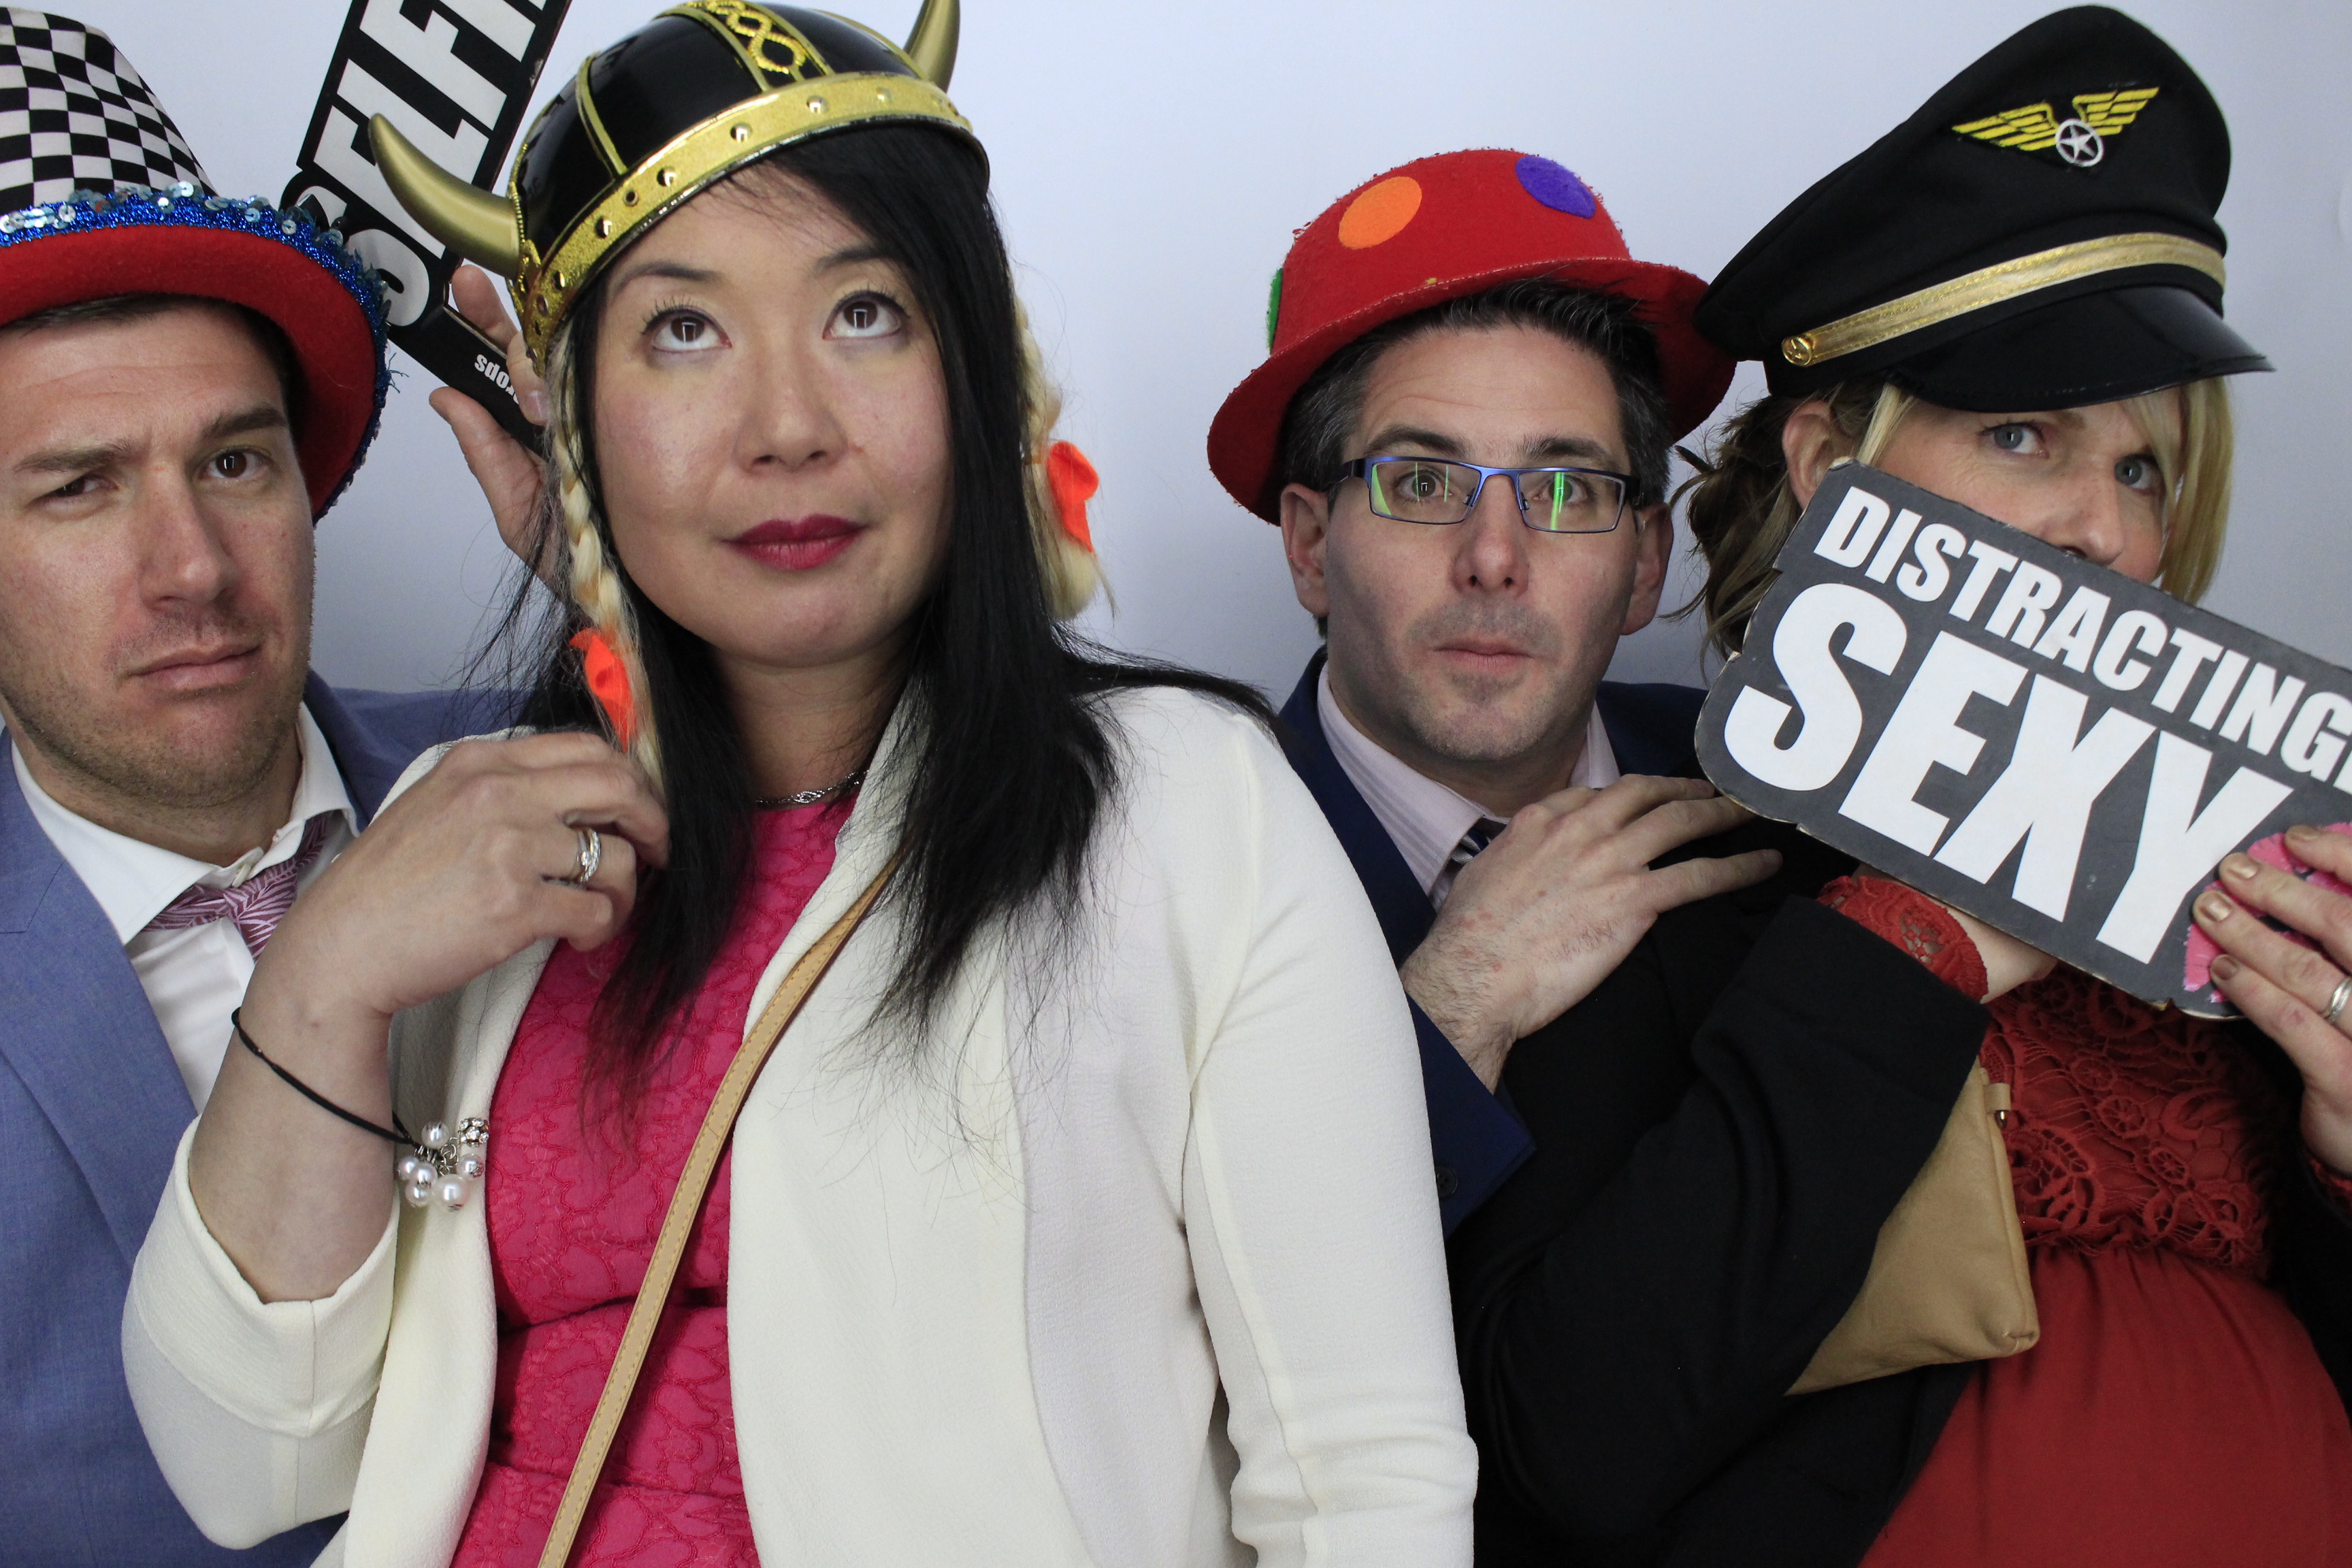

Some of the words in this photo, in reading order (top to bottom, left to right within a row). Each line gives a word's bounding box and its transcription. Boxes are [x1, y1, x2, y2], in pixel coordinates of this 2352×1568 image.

[474, 354, 519, 404] rops
[1724, 583, 2294, 964] SEXY
[1813, 486, 2352, 796] DISTRACTING
